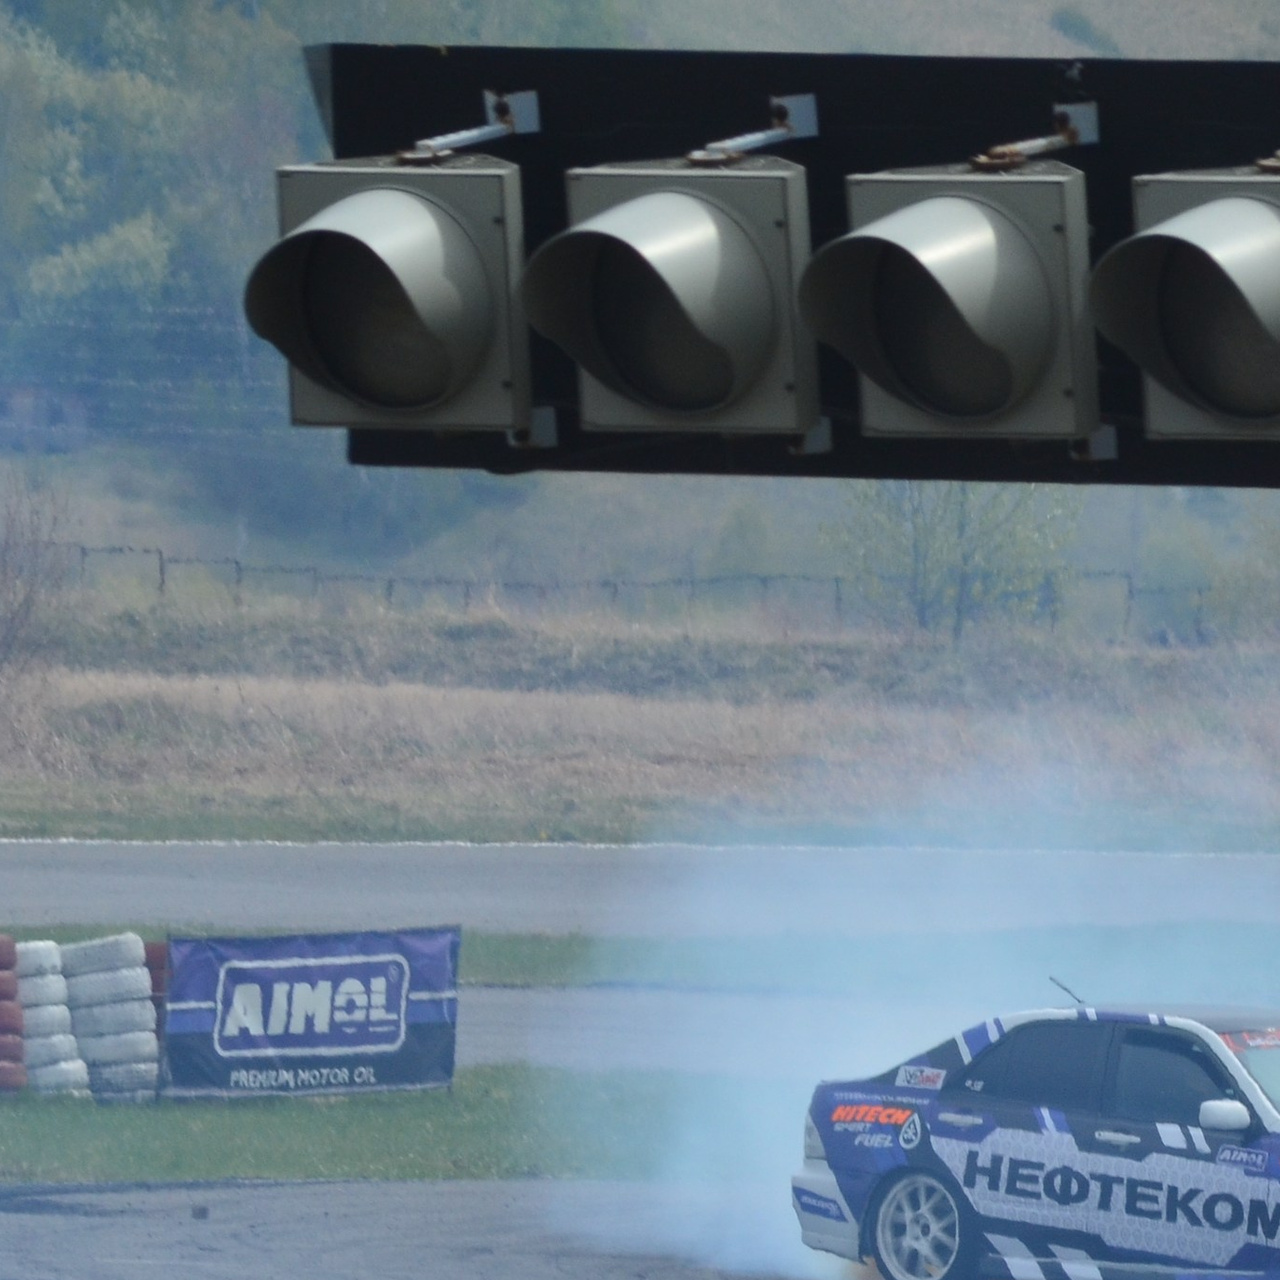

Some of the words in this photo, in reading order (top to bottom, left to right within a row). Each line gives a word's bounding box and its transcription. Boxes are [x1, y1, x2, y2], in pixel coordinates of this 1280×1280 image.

[223, 976, 398, 1036] AIMOL
[230, 1069, 294, 1088] PREMIUM
[297, 1067, 350, 1085] MOTOR
[354, 1066, 376, 1083] OIL
[831, 1104, 912, 1125] HITECH
[854, 1133, 893, 1148] FUEL
